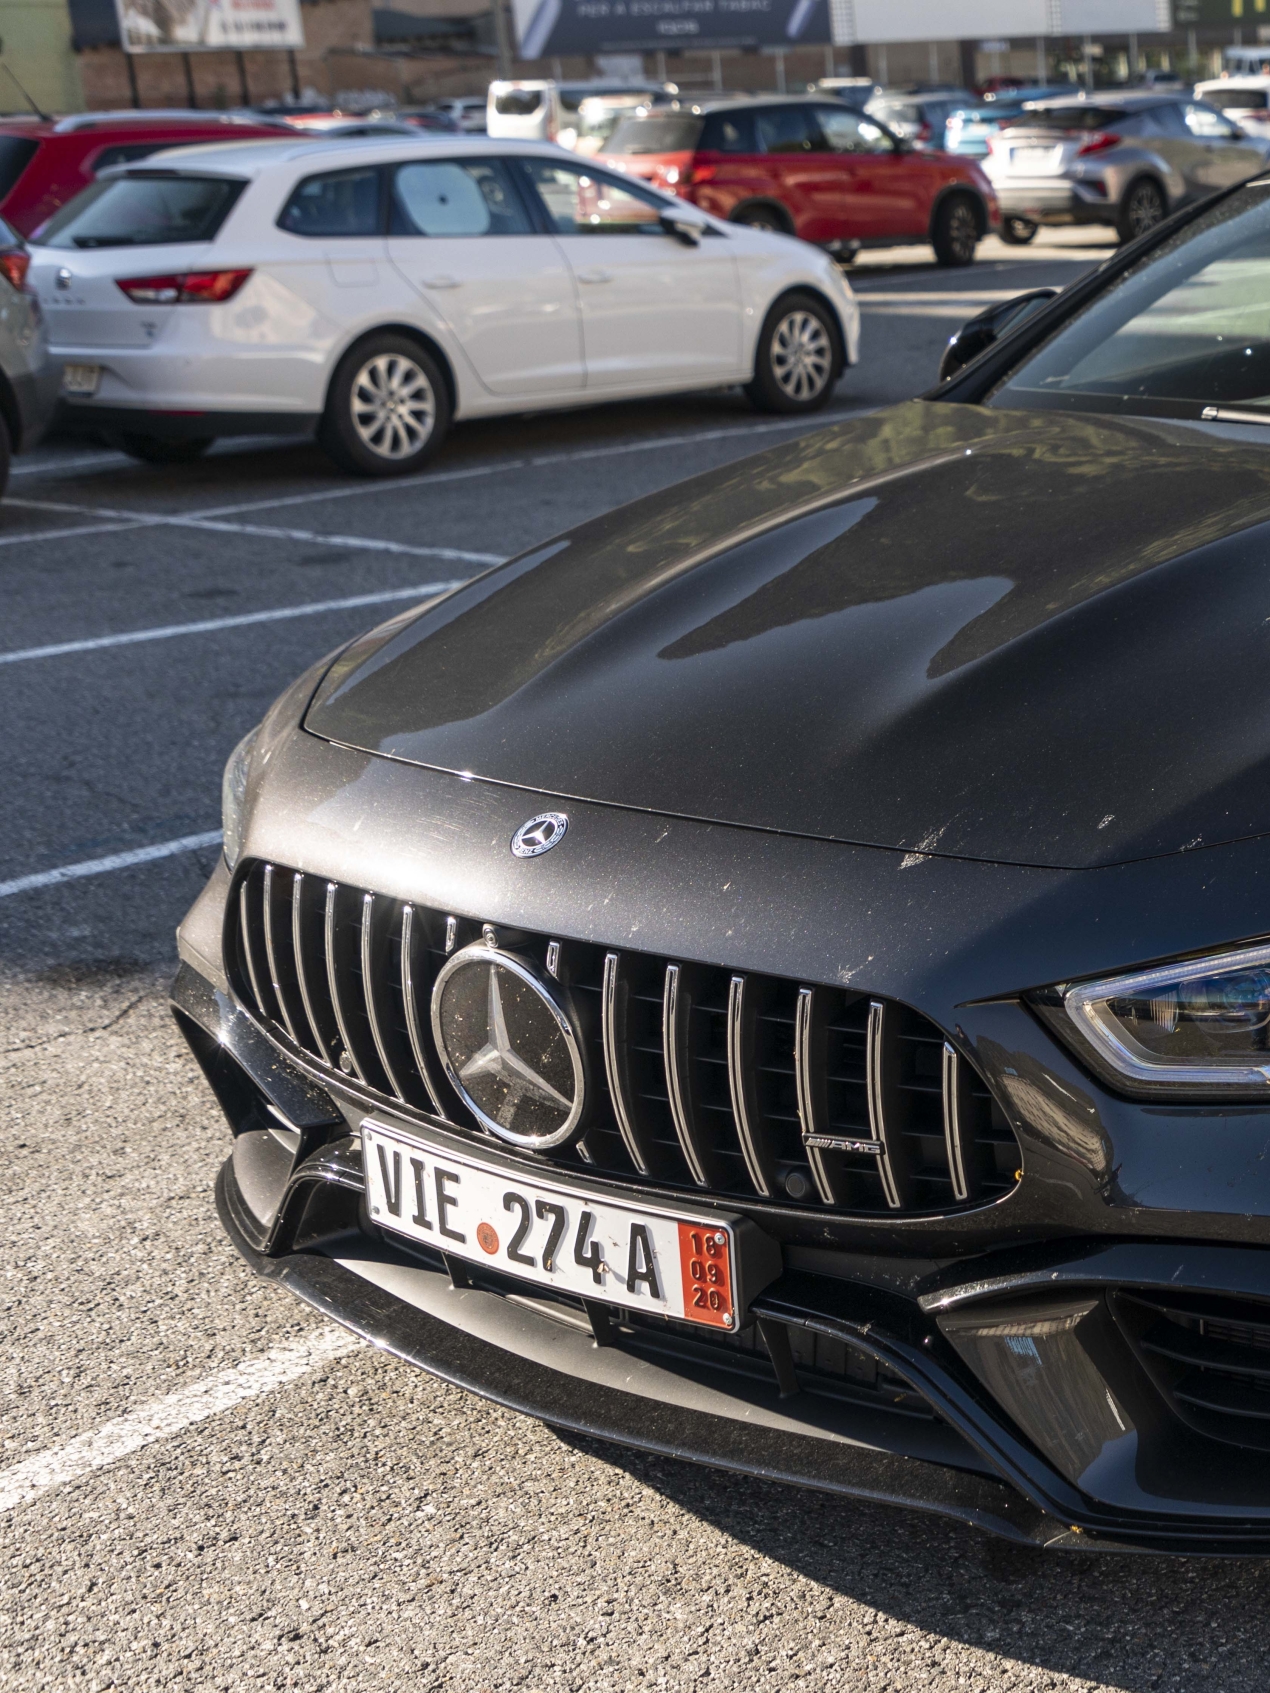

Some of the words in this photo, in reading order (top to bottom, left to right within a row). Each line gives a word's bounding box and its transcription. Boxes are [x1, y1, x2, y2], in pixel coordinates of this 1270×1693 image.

[377, 1144, 467, 1243] VIE
[502, 1191, 603, 1285] 274
[690, 1231, 717, 1256] 18
[690, 1258, 716, 1284] 09
[692, 1284, 720, 1311] 20
